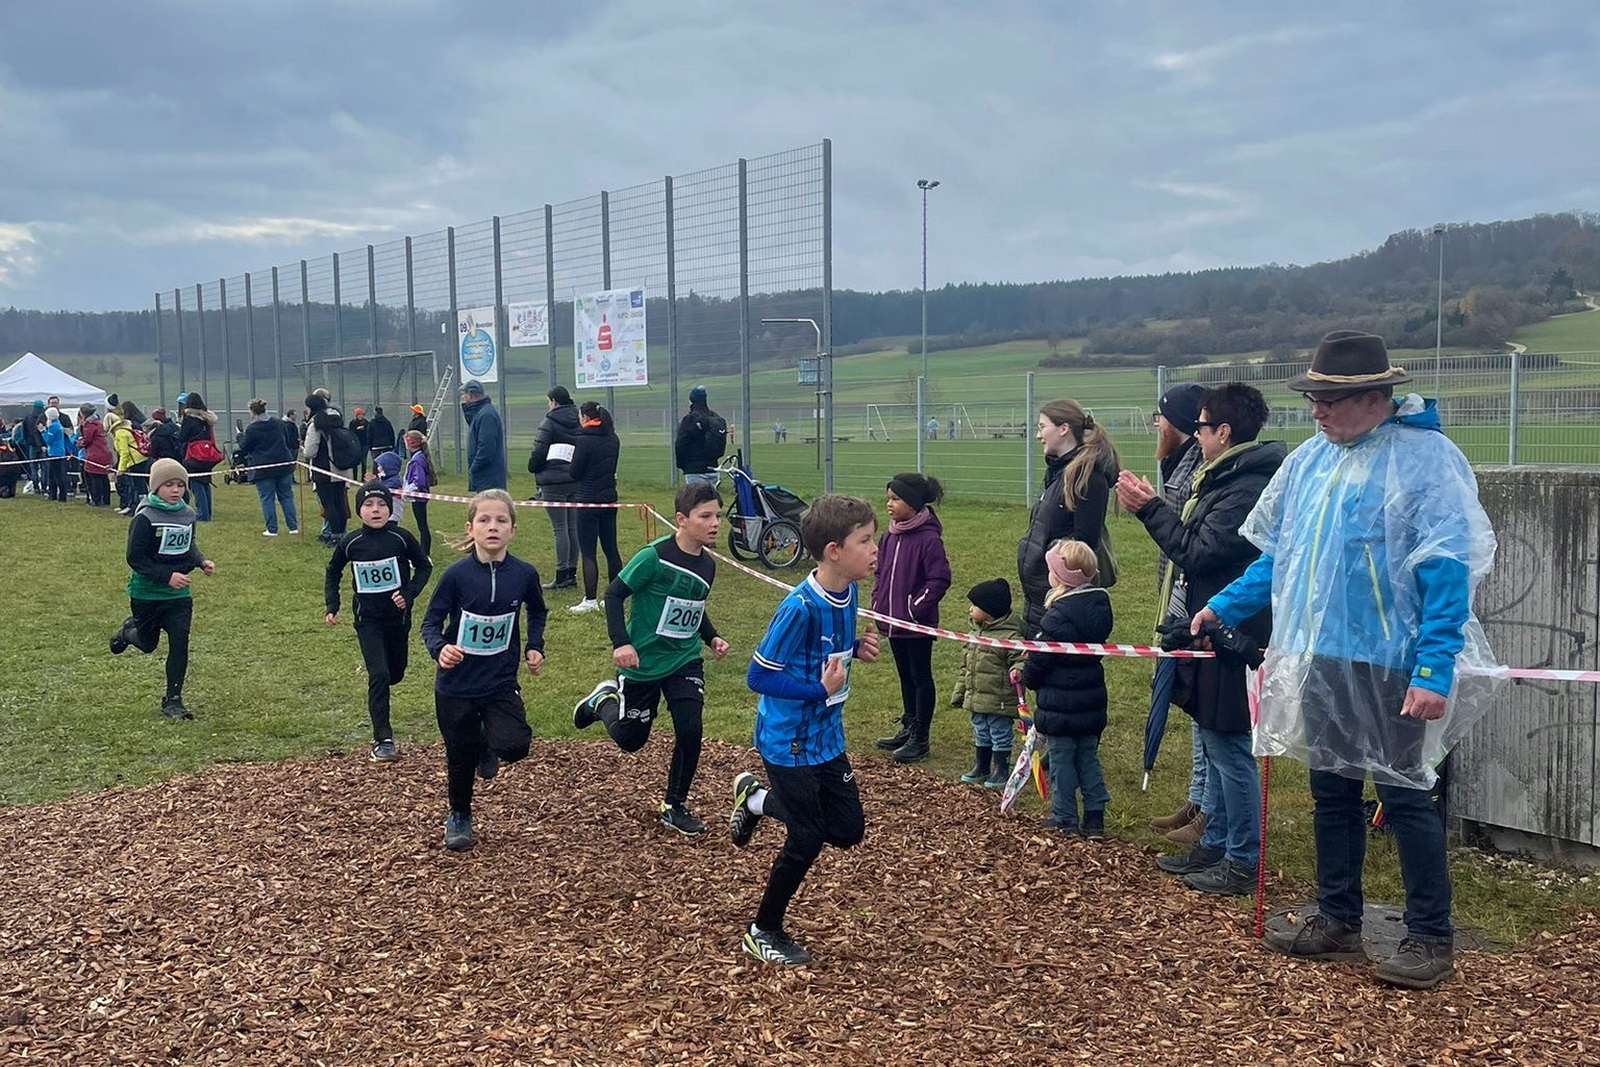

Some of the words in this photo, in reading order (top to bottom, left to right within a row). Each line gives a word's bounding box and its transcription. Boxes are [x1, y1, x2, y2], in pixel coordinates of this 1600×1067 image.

[361, 567, 393, 584] 186
[668, 608, 701, 627] 206
[469, 623, 506, 644] 194
